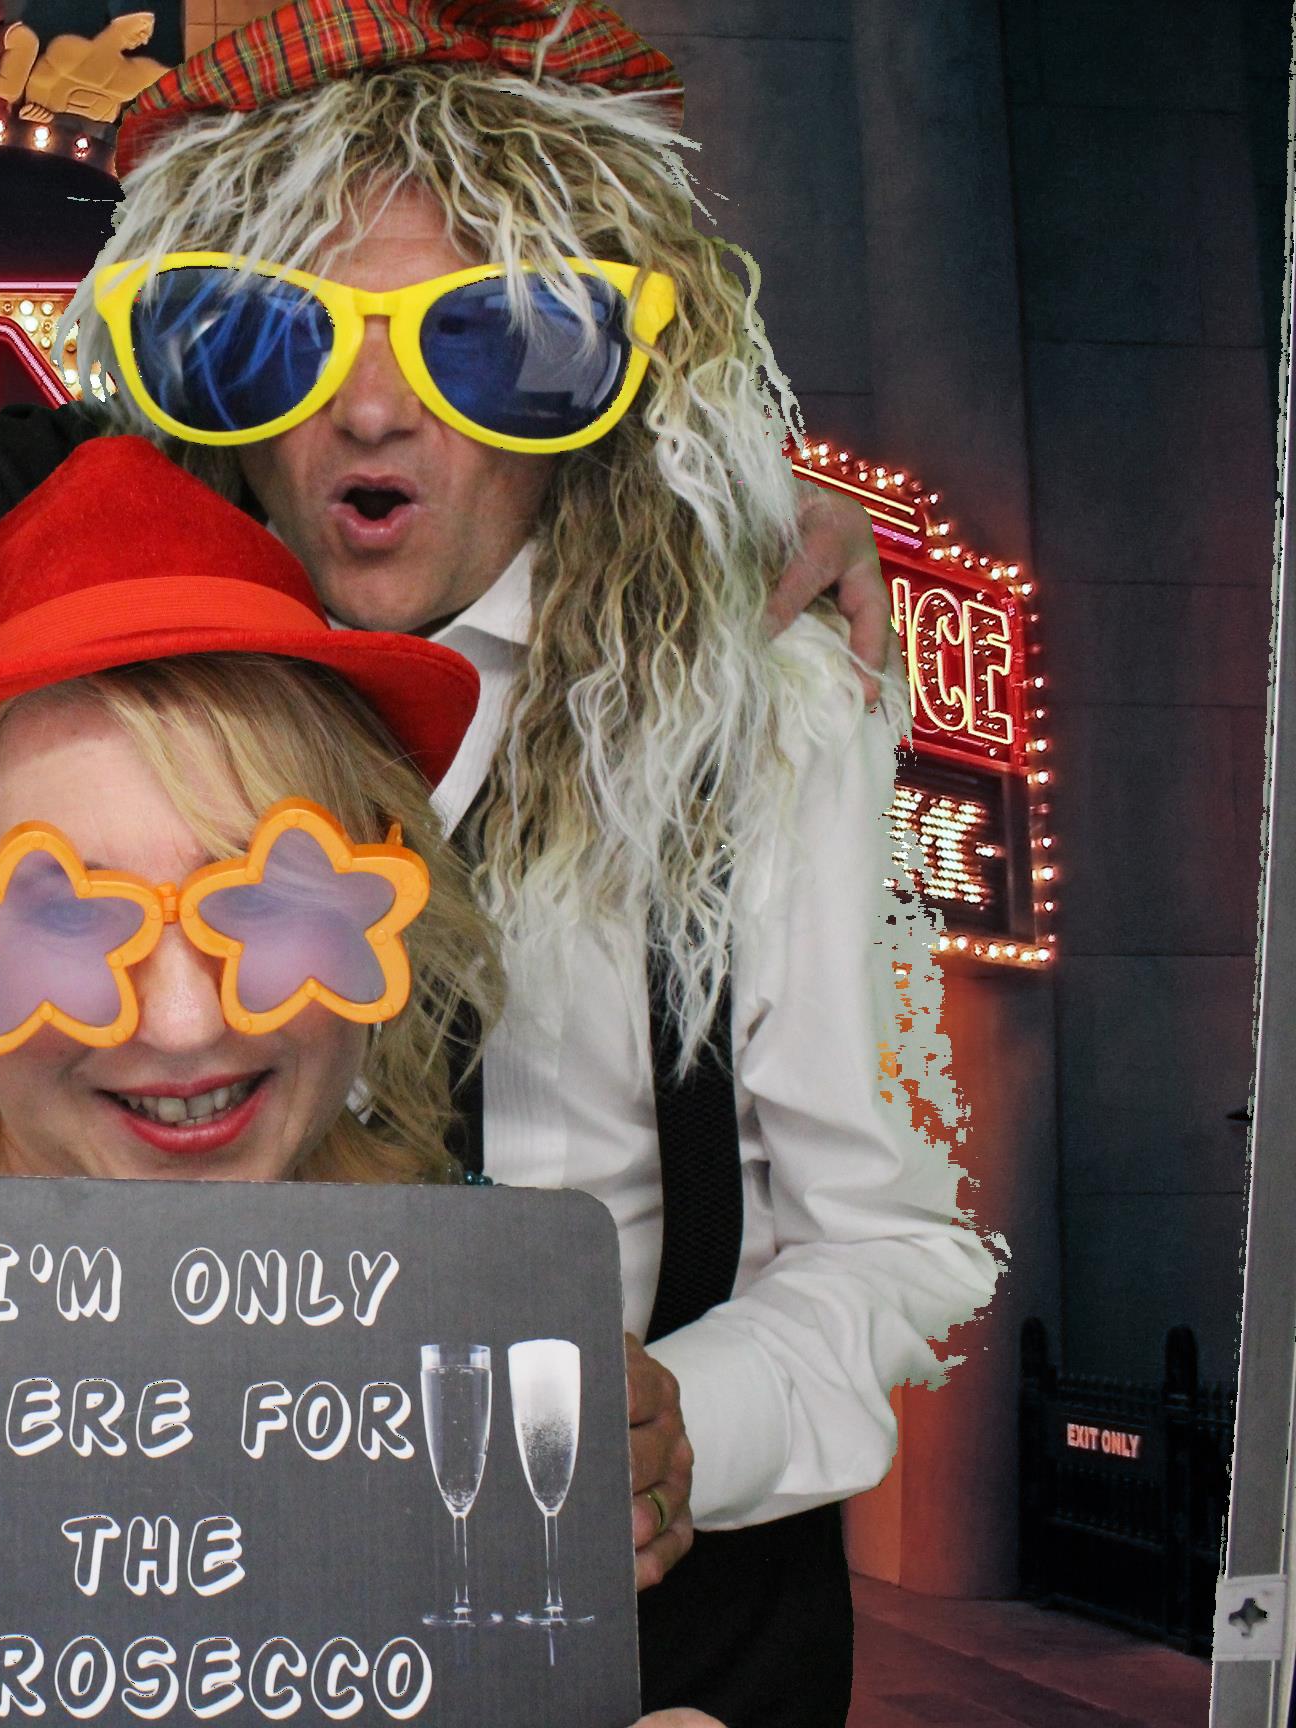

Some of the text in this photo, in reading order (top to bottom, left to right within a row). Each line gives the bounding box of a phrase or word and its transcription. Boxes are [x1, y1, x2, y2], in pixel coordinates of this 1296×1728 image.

[172, 1246, 400, 1326] ONLY
[241, 1380, 415, 1460] FOR
[1067, 1423, 1140, 1458] EXIT ONLY
[62, 1514, 246, 1597] THE
